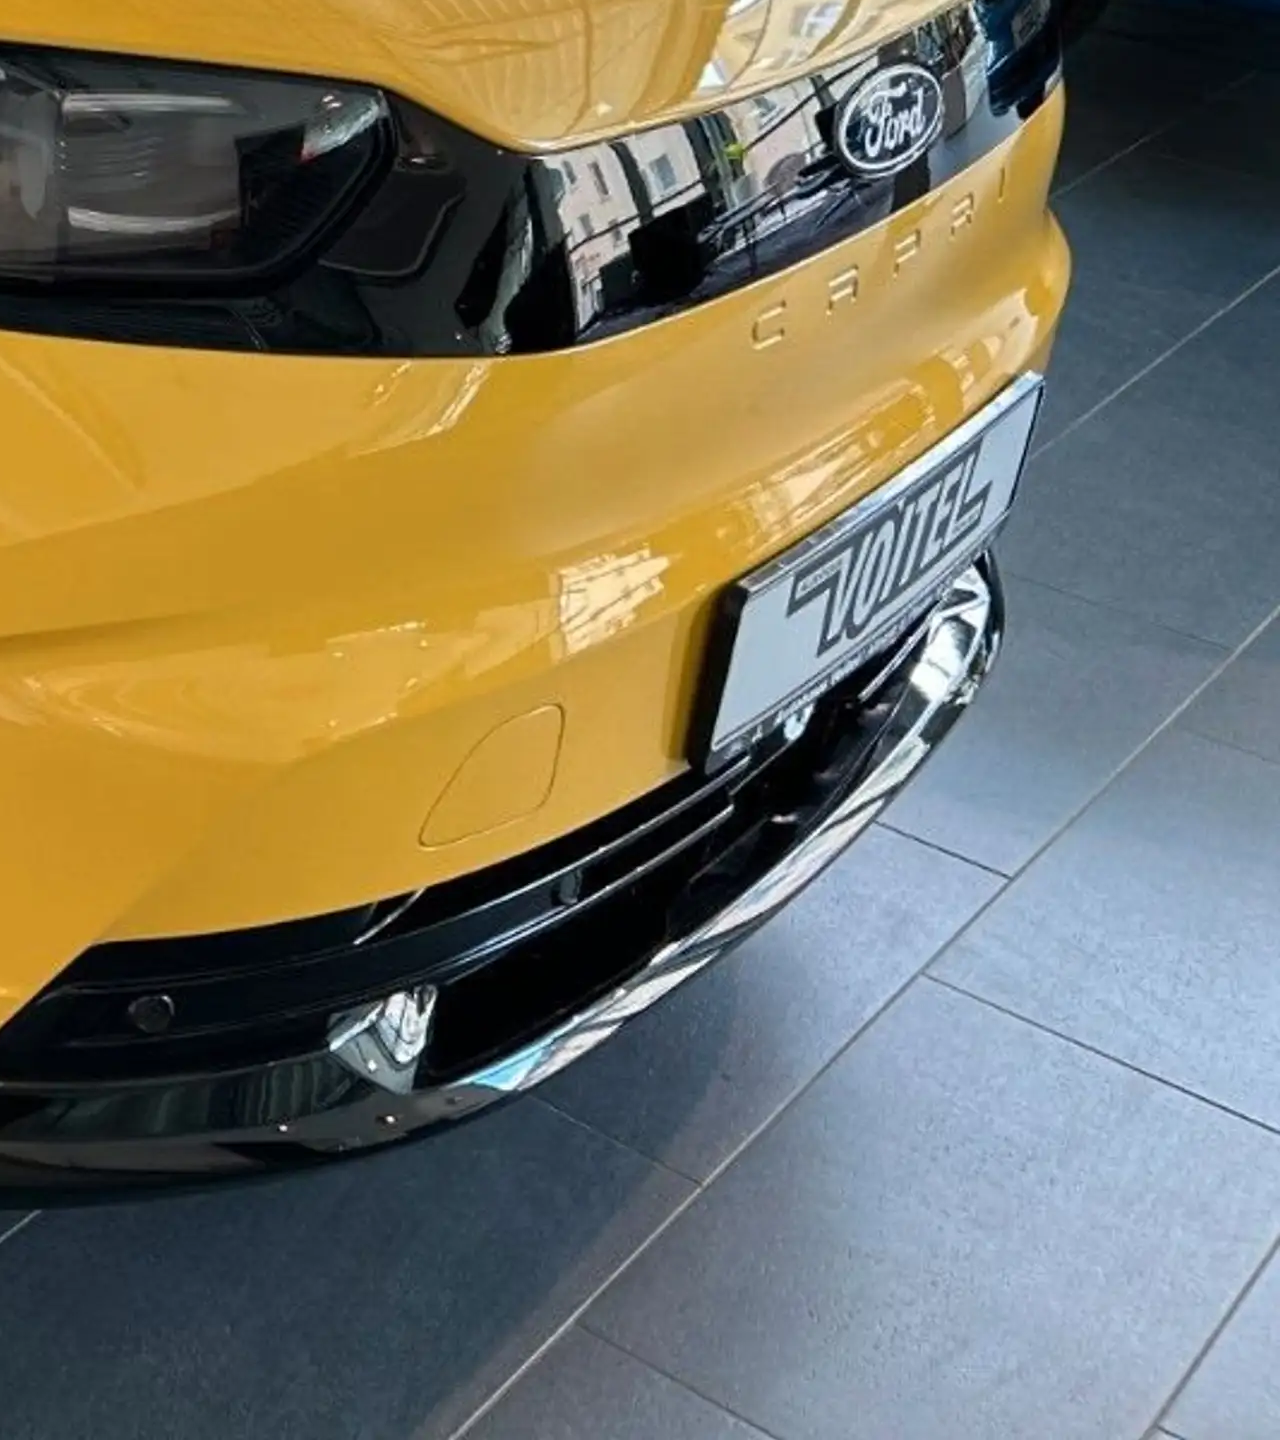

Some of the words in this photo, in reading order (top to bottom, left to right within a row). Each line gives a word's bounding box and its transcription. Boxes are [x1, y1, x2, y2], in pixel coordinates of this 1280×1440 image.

[863, 79, 927, 158] Ford
[751, 166, 1006, 351] CAPRI
[786, 437, 992, 658] VOITEL
